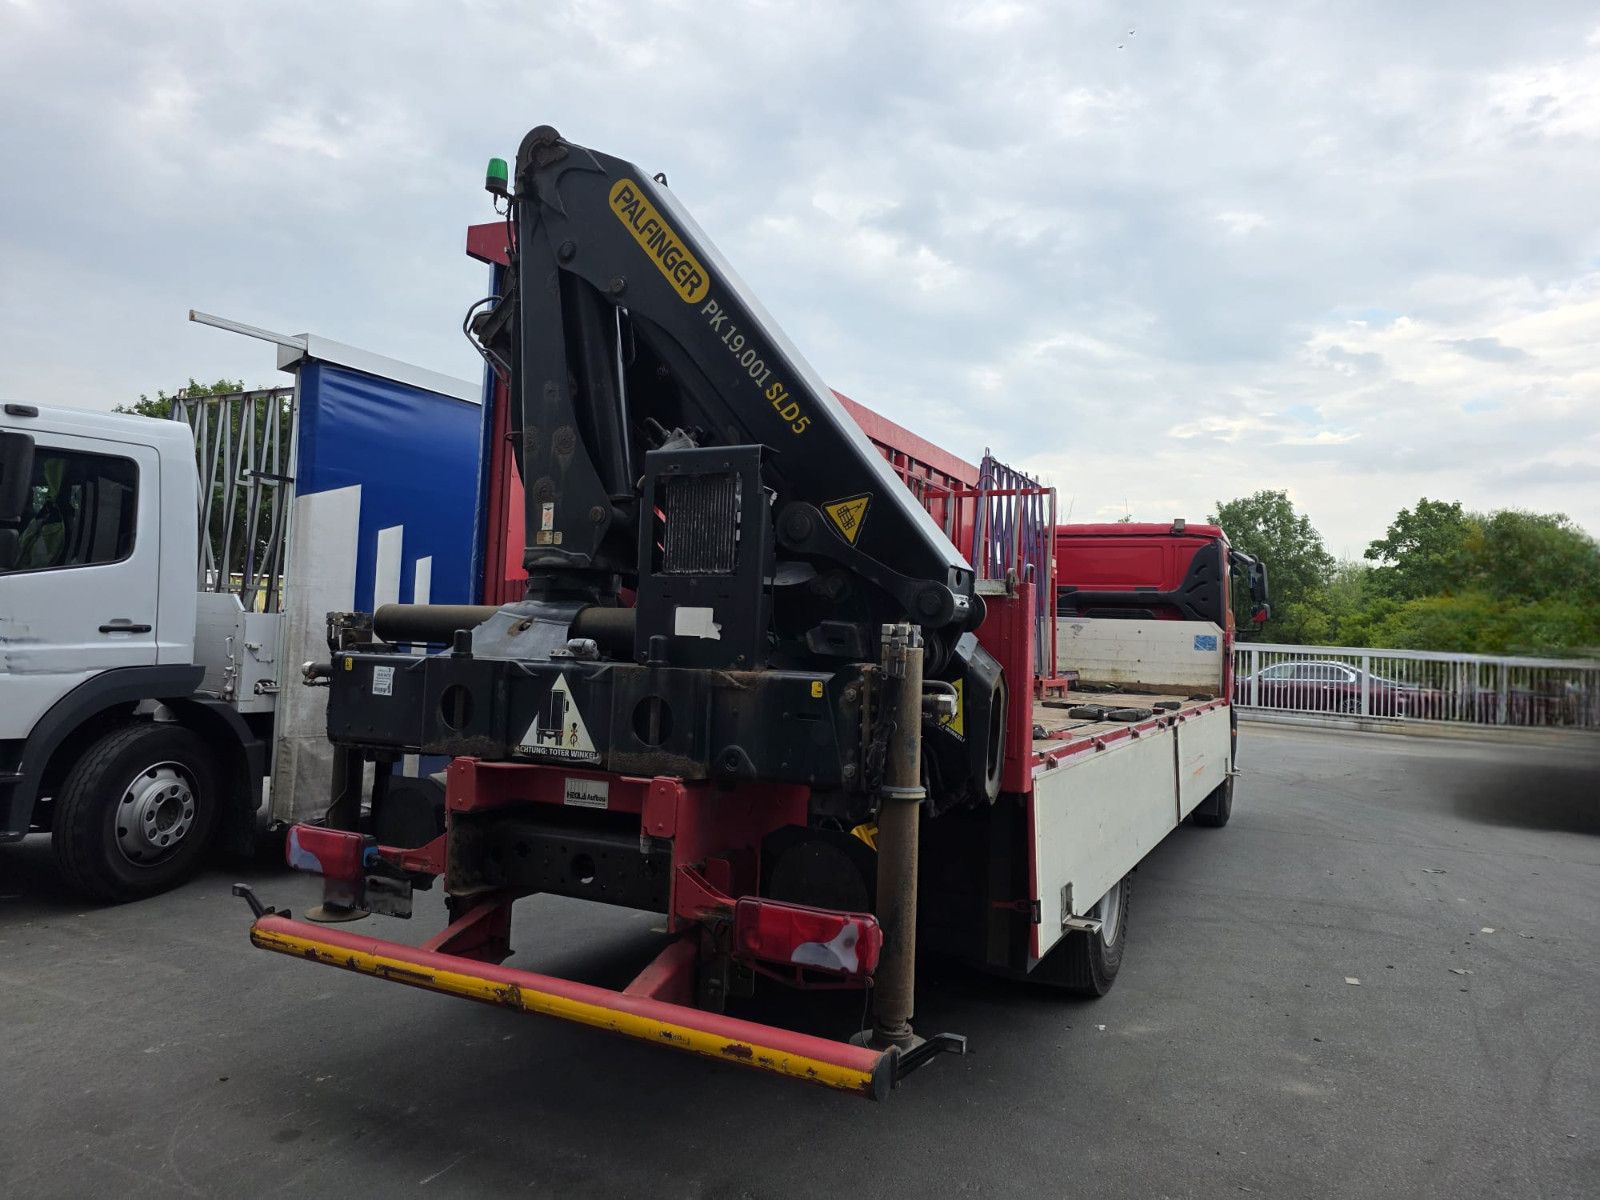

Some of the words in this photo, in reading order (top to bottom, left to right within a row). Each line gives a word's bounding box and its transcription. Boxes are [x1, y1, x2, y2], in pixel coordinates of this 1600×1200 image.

[613, 184, 703, 298] PALFINGER
[700, 299, 729, 332] PK
[721, 325, 772, 388] 19.001
[549, 748, 570, 758] TOTER
